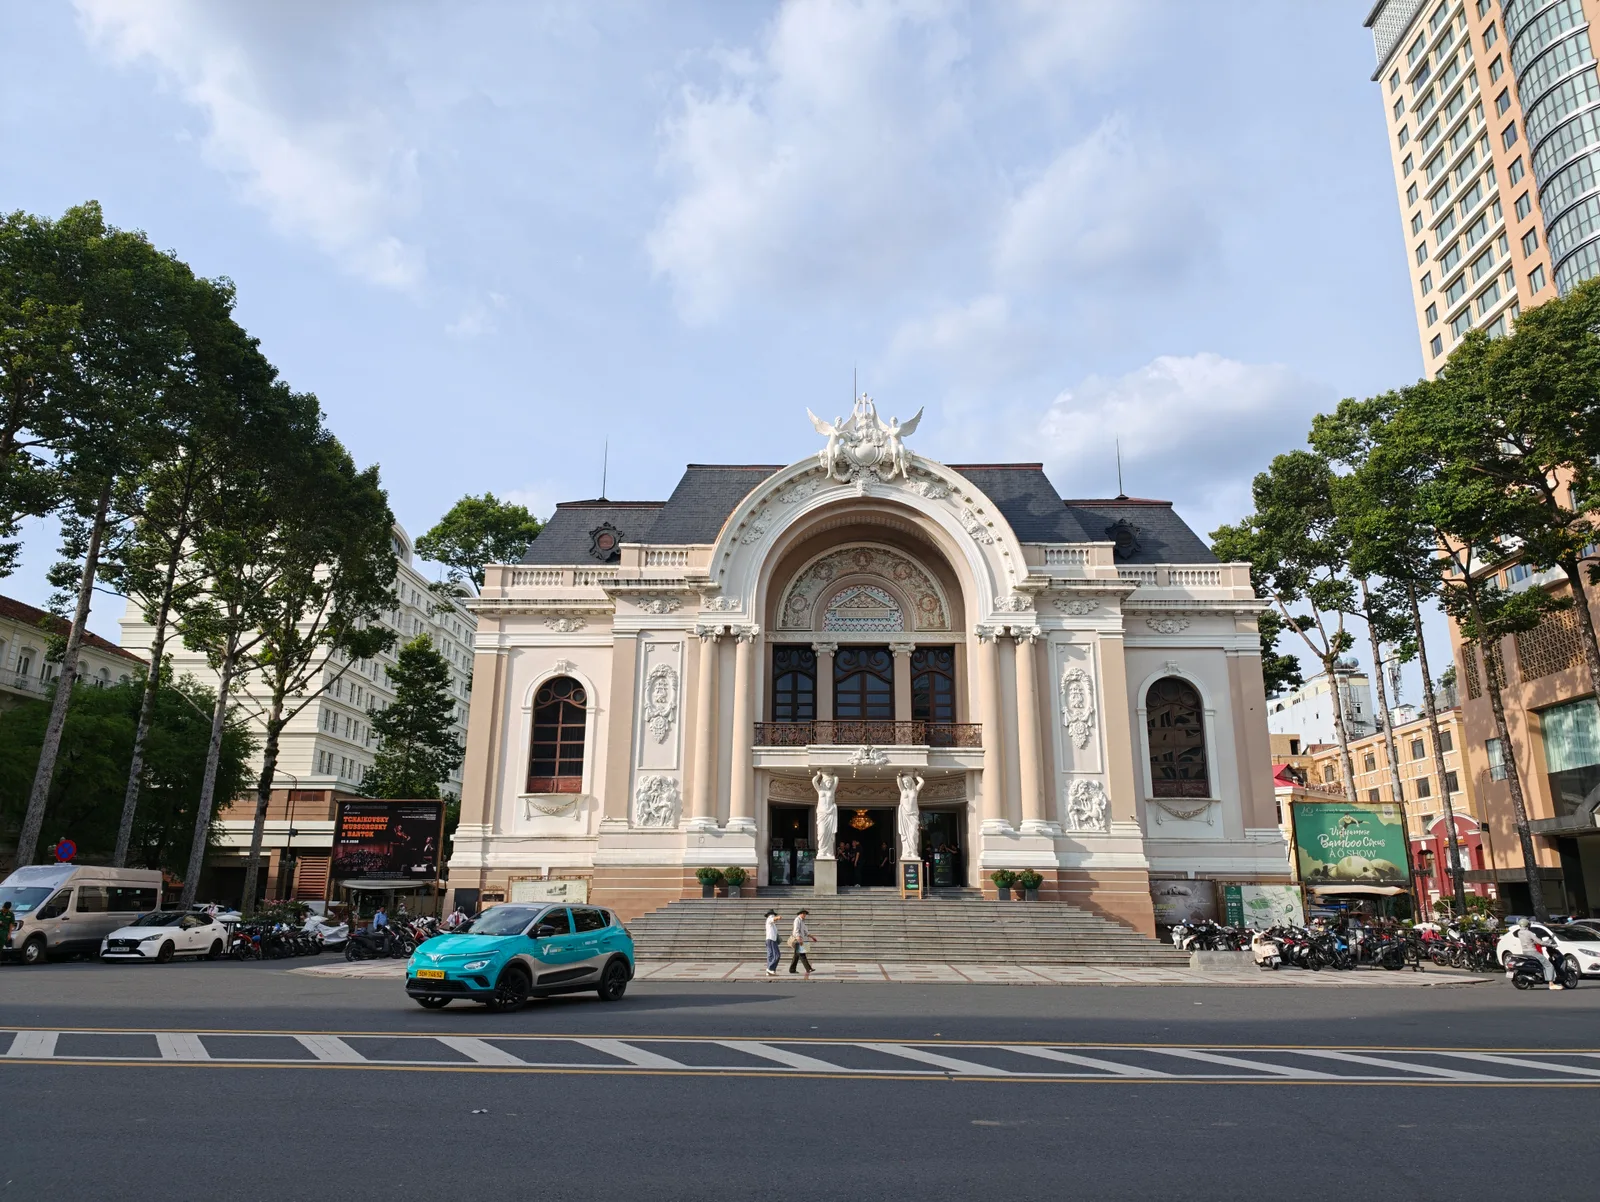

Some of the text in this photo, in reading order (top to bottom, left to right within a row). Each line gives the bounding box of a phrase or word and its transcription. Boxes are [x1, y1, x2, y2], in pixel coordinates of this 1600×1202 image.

[1329, 826, 1370, 836] Vietnamese
[1317, 834, 1385, 848] Bamboo Circus
[1346, 849, 1376, 858] SHOW
